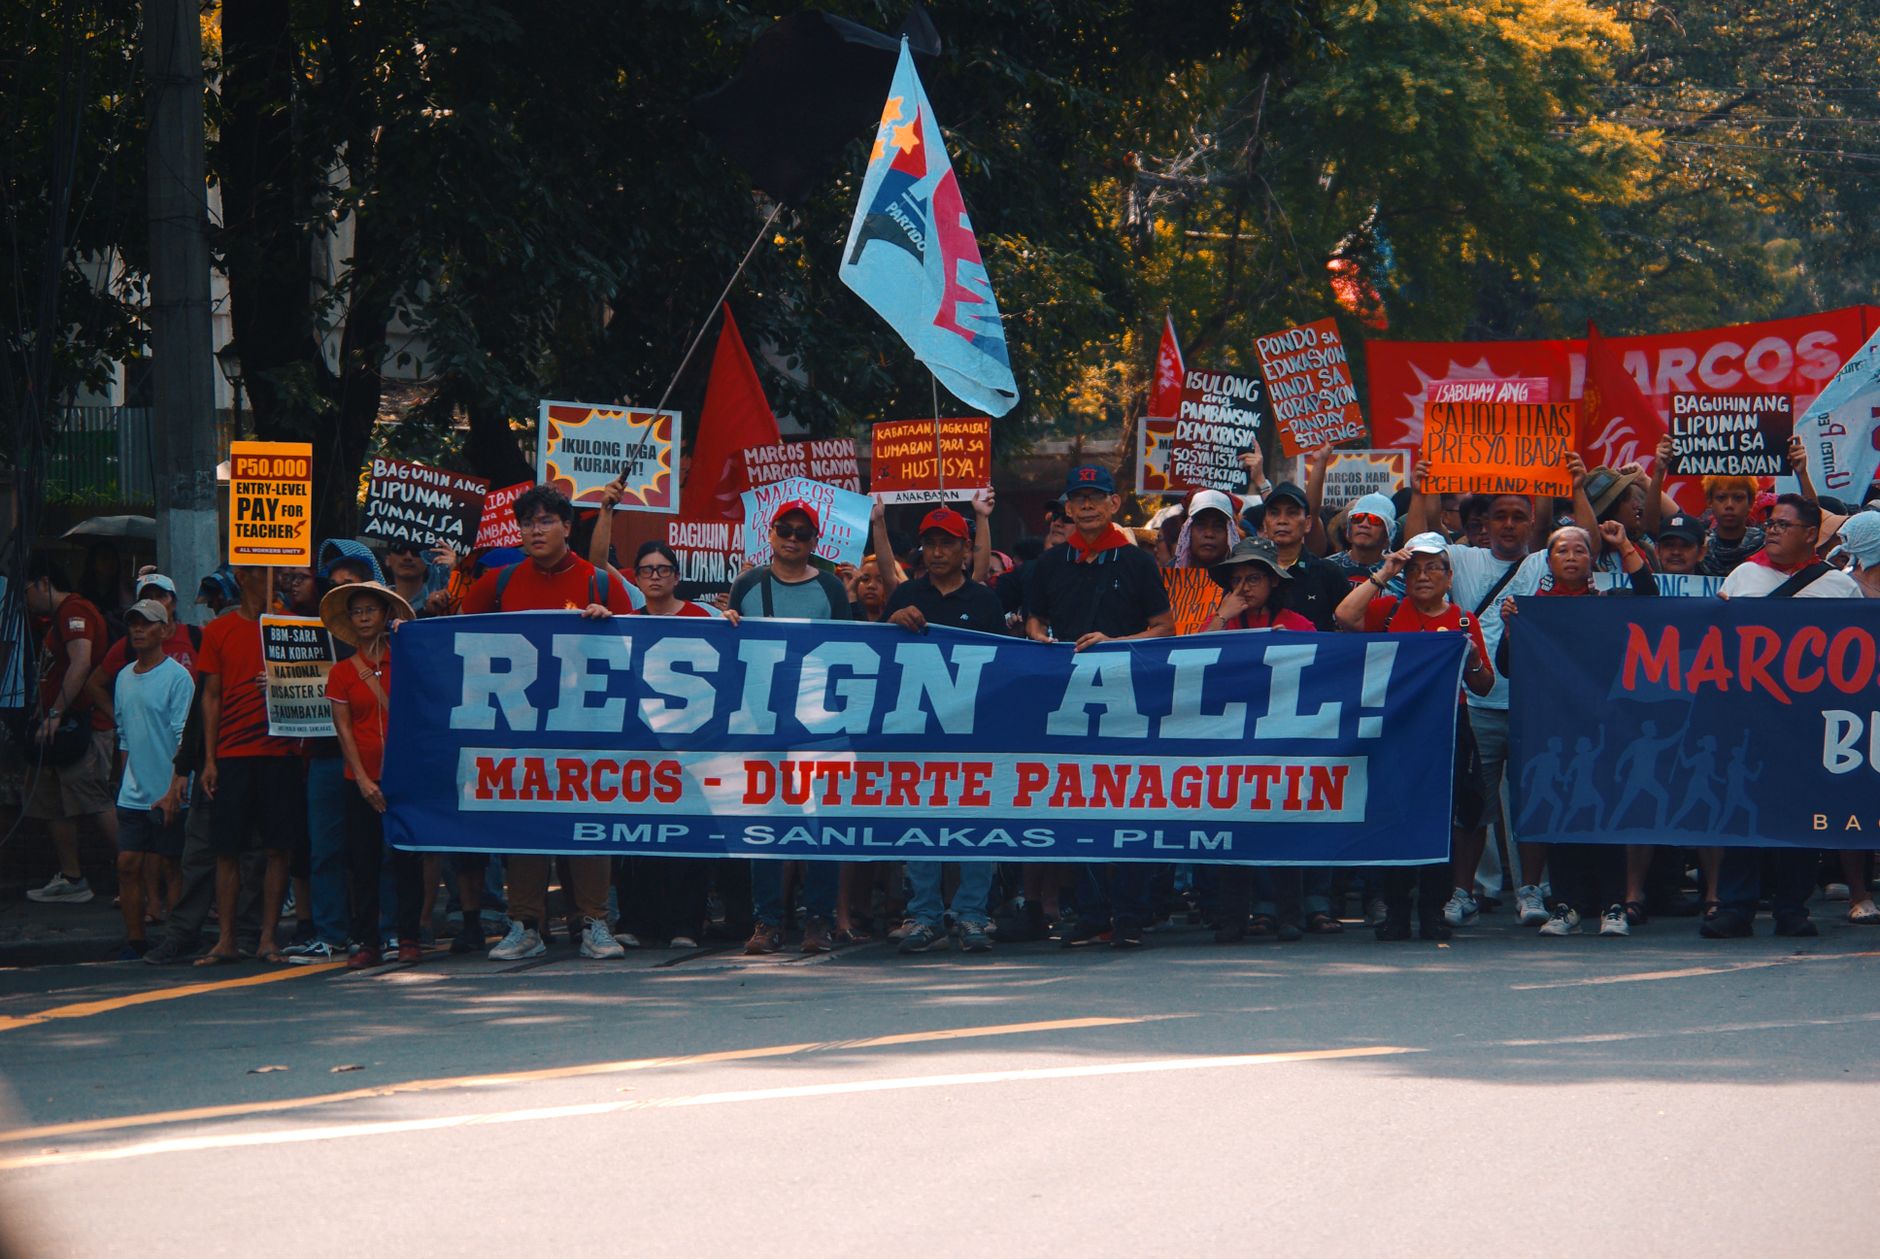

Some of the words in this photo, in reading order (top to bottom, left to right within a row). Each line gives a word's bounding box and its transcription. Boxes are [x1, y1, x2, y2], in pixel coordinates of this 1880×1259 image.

[885, 200, 926, 253] PARTIDO
[1257, 328, 1316, 362] PONDO
[1321, 332, 1338, 344] SA
[1263, 345, 1346, 380] EDUKASYON
[1185, 371, 1260, 402] ISULONG
[1269, 374, 1314, 402] HINDI
[1318, 366, 1346, 388] SA
[1435, 383, 1496, 403] ISABUHAY
[1496, 382, 1528, 403] ANG
[1202, 395, 1235, 408] ang
[1273, 384, 1357, 421] KORAPSYON
[1674, 395, 1750, 413] BAGUHIN
[1753, 396, 1789, 412] ANG
[1180, 401, 1261, 428] PAMBANSANG
[1515, 403, 1571, 438] ITAAS
[1674, 414, 1758, 436] LIPUNAN
[1176, 421, 1255, 449] DEMOKRASYA
[1672, 434, 1735, 456] SUMALI
[1740, 432, 1764, 452] SA
[562, 437, 620, 457] IKULONG
[626, 443, 657, 461] MGA
[744, 444, 805, 465] MARCOS
[811, 439, 855, 461] NOON
[877, 441, 932, 458] LUMABAN
[940, 439, 963, 452] PARA
[967, 440, 984, 452] SA
[1193, 442, 1210, 451] na
[1213, 443, 1238, 456] may
[1514, 436, 1568, 467] IBABA
[237, 458, 307, 478] P50,000
[373, 458, 451, 487] BAGUHIN
[454, 478, 487, 496] ANG
[574, 456, 643, 476] KURAKOT!
[747, 460, 808, 483] MARCOS
[811, 459, 857, 478] NGAYON
[1175, 464, 1247, 485] PERSPEKTIBA
[1325, 471, 1361, 483] ARCOS
[1366, 472, 1390, 483] HARI
[1677, 455, 1781, 475] ANAKBAYAN
[236, 482, 307, 496] ENTRY-LEVEL
[754, 479, 835, 512] MARCOS
[1327, 484, 1341, 496] NG
[1345, 484, 1379, 497] KORAP
[237, 497, 279, 521] PAY
[282, 505, 303, 517] FOR
[367, 500, 435, 528] SUMALI
[434, 515, 463, 536] SA
[668, 522, 729, 551] BAGUHIN
[270, 628, 318, 643] BBM-SARA
[268, 645, 286, 659] MGA
[289, 646, 325, 660] KORAP!
[1622, 623, 1880, 704] MARCO
[274, 665, 322, 679] NATIONAL
[271, 684, 315, 699] DISASTER
[449, 632, 998, 735] RESIGN
[1046, 641, 1400, 739] ALL!
[1821, 708, 1880, 774] B
[474, 757, 683, 803] MARCOS
[703, 777, 721, 787] -
[742, 760, 993, 808] DUTERTE
[1012, 762, 1350, 811] PANAGUTIN
[572, 822, 690, 846] BMP
[708, 832, 726, 840] -
[742, 824, 1056, 848] SANLAKAS
[1076, 837, 1096, 845] -
[1112, 829, 1234, 851] PLM
